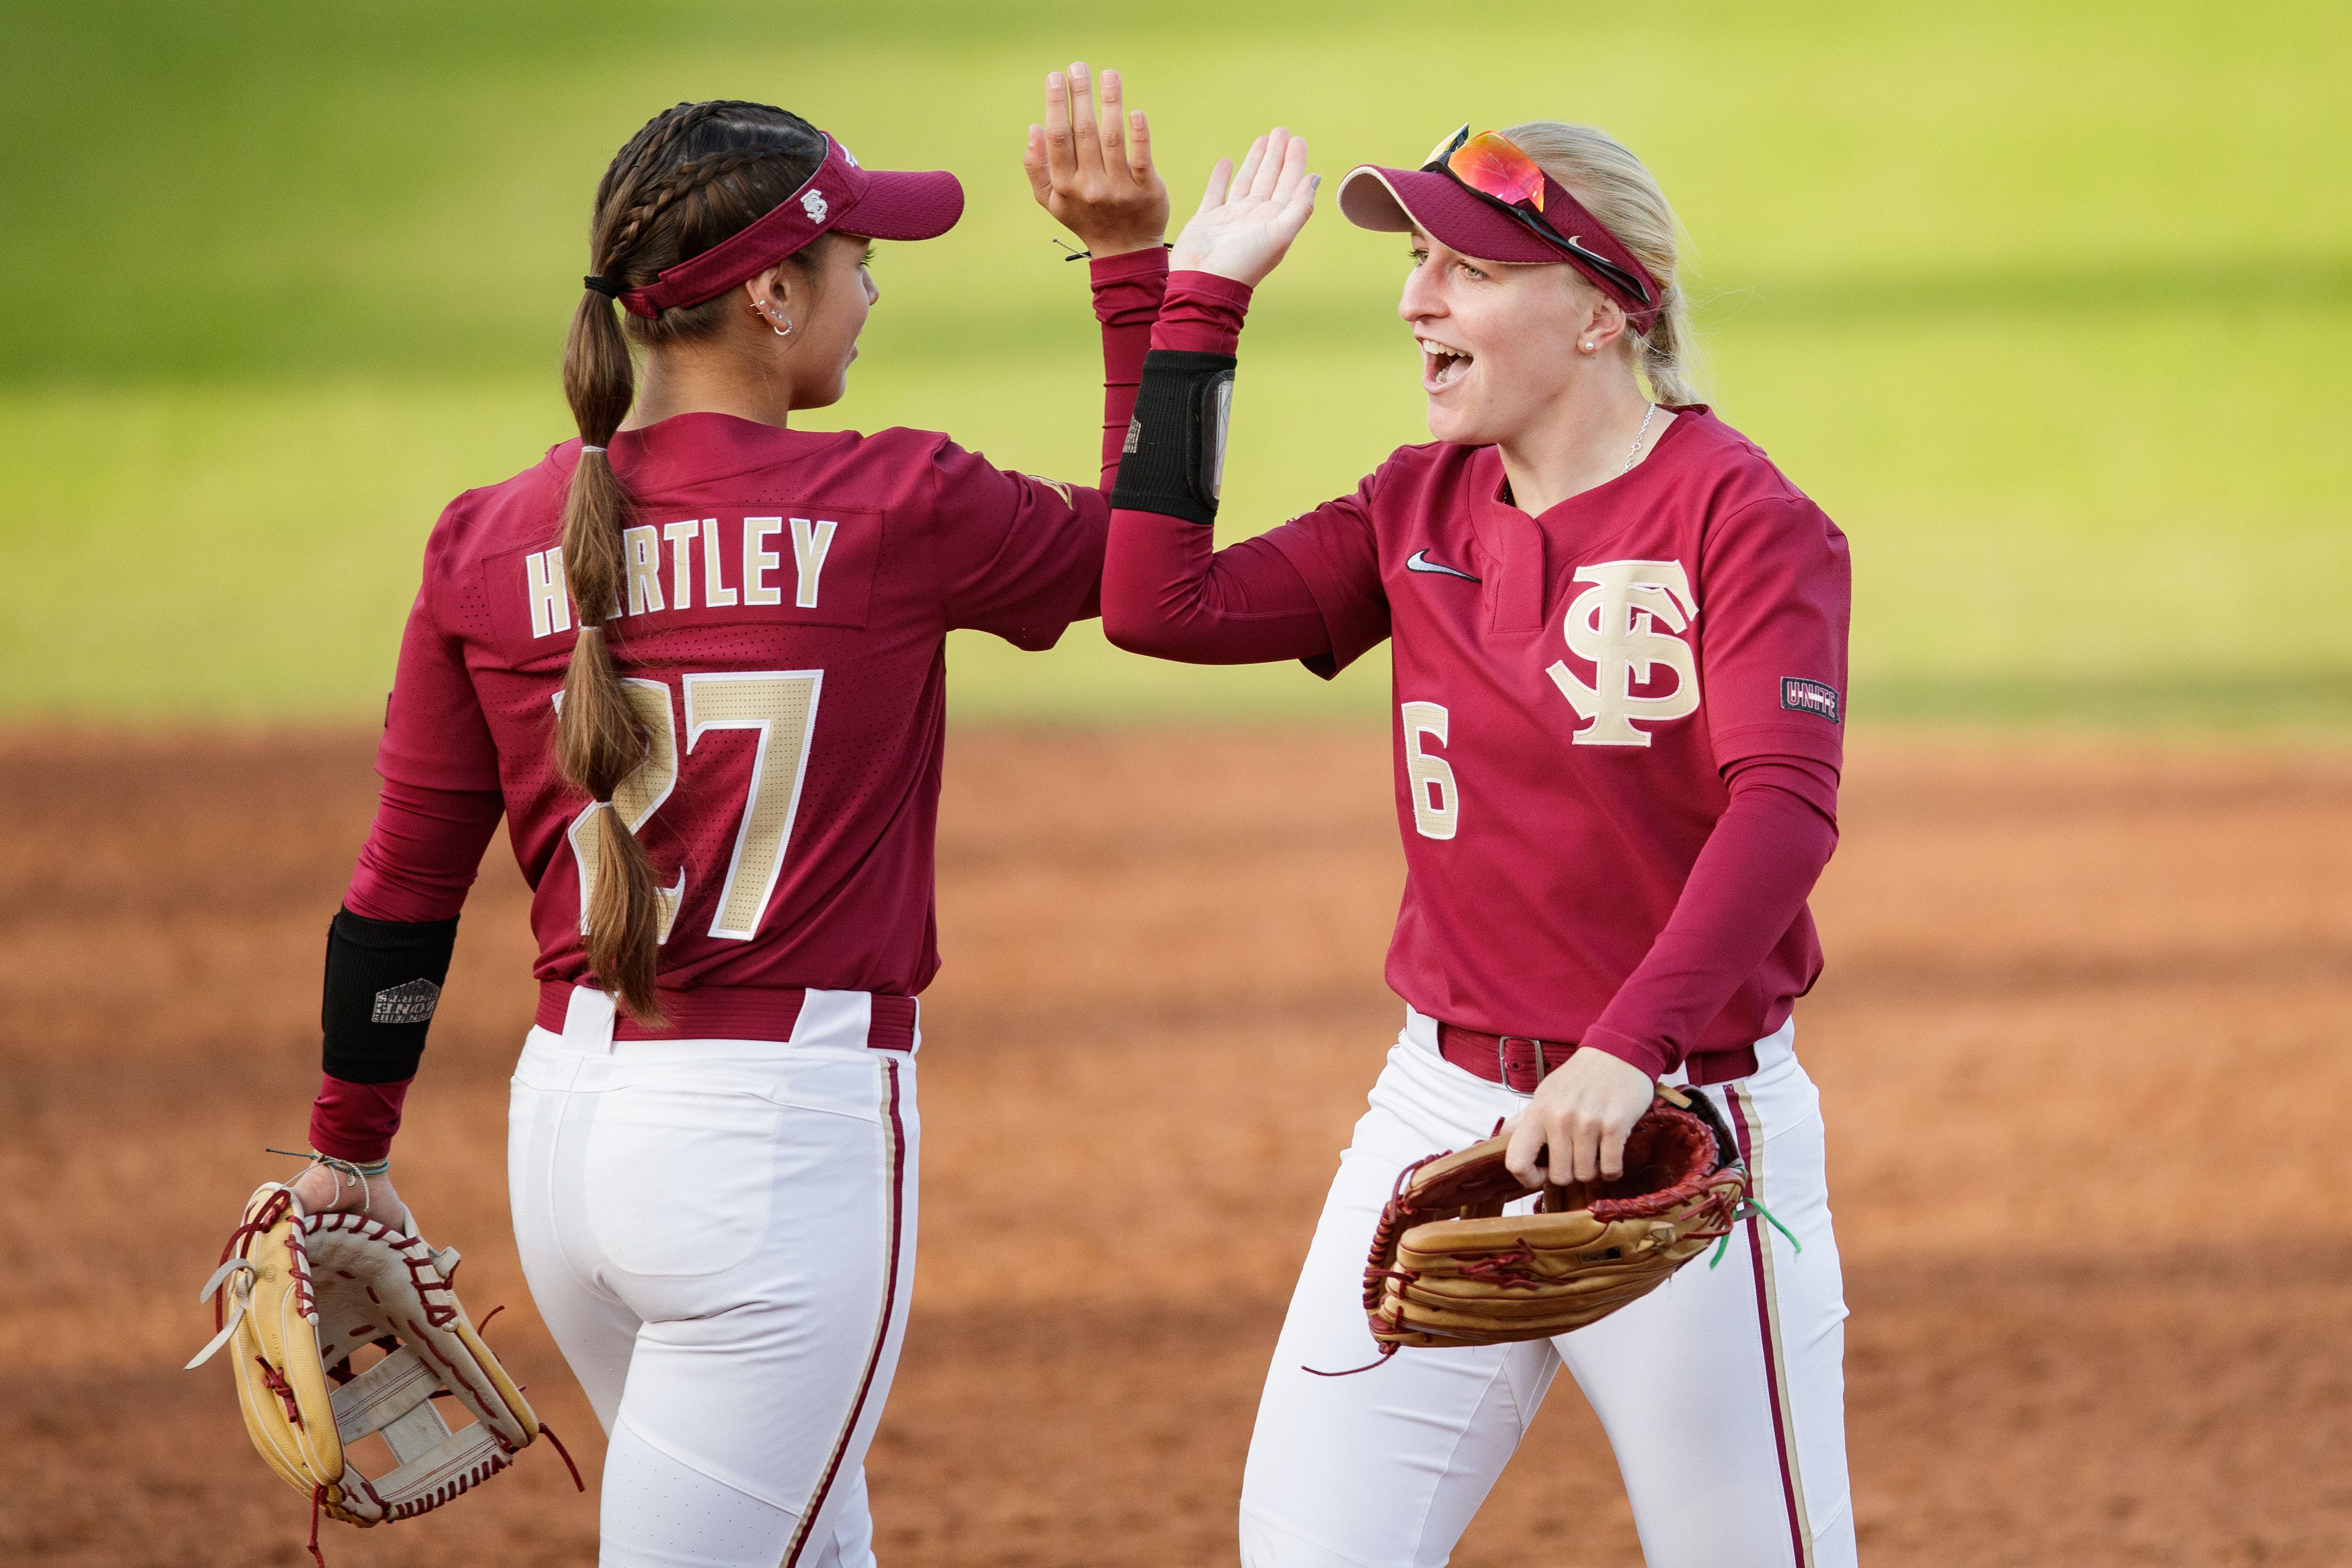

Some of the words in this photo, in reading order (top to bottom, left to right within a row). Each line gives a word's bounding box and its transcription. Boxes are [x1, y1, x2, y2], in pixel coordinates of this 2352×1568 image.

[526, 516, 838, 639] HRTLEY
[1787, 681, 1835, 717] UNITE
[552, 669, 824, 944] 27
[1401, 701, 1459, 840] 6
